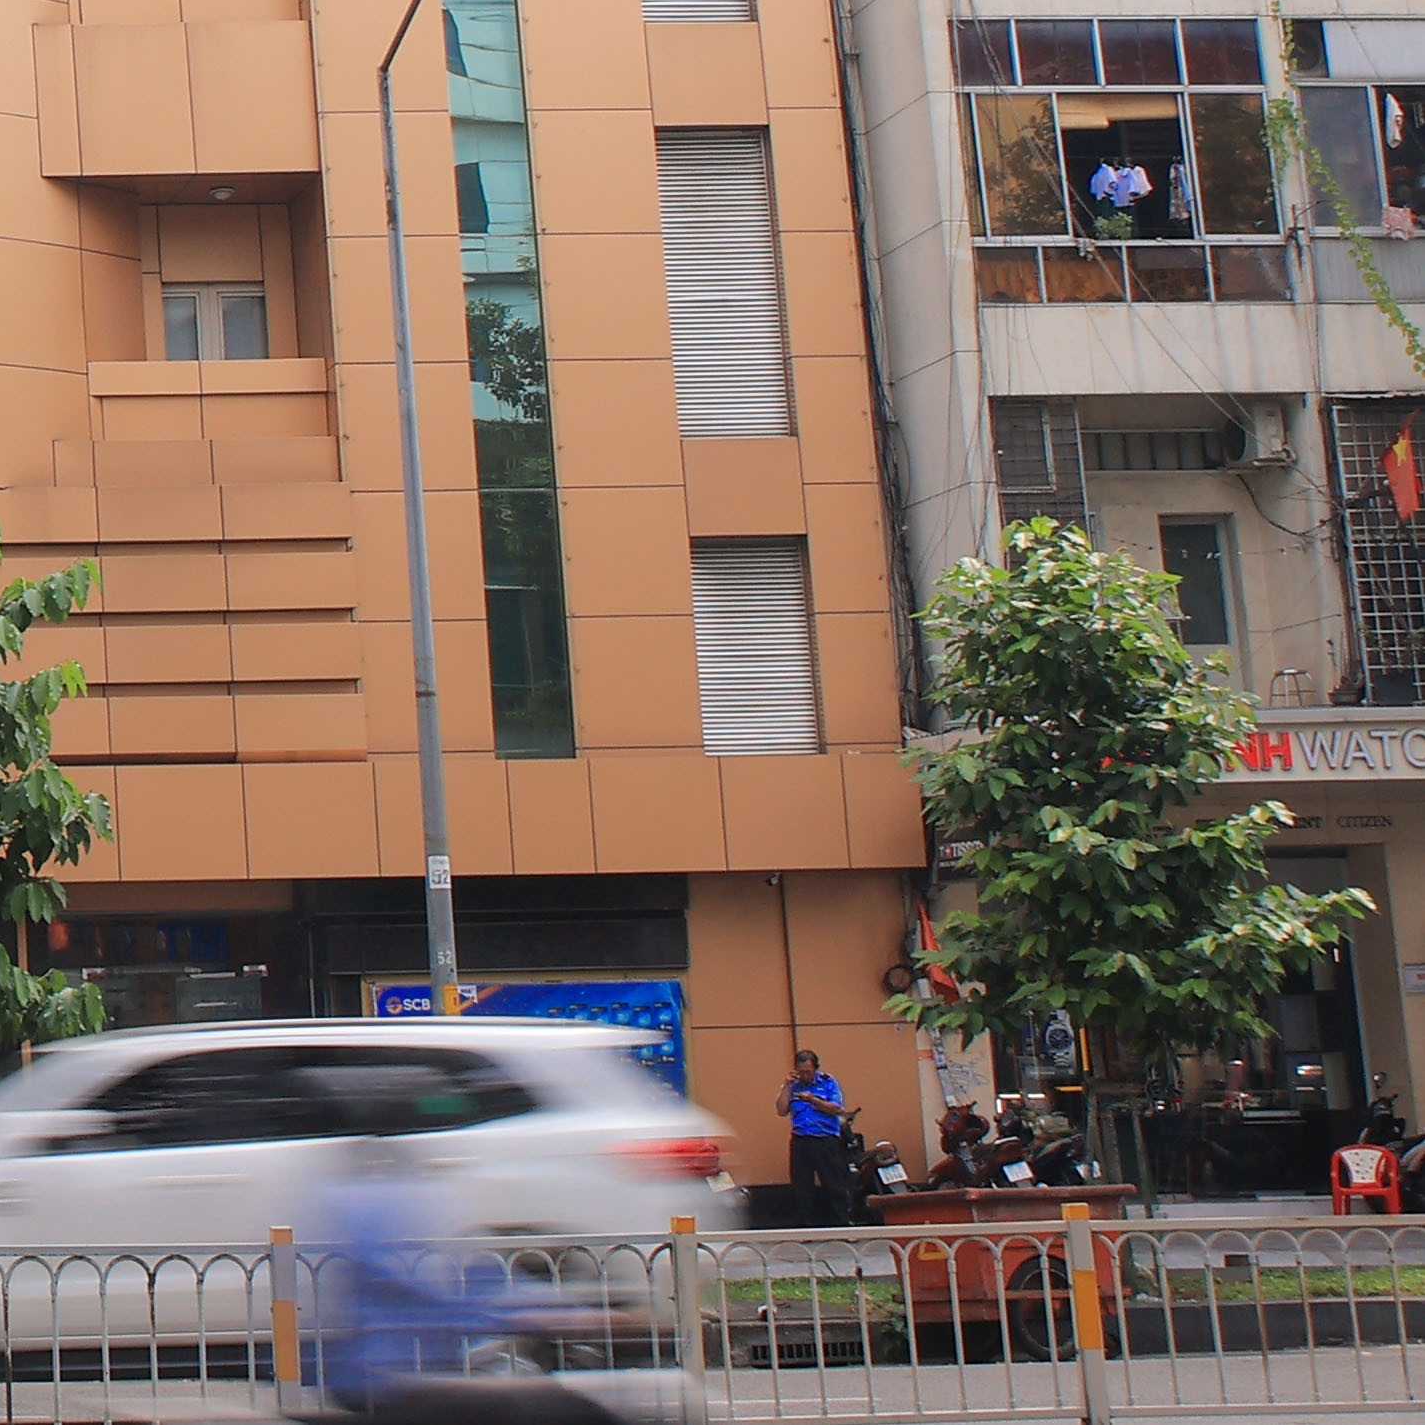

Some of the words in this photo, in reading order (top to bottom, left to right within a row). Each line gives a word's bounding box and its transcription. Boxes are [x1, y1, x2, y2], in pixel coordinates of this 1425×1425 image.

[431, 869, 451, 885] 52
[437, 951, 453, 965] 52
[403, 999, 431, 1011] SCB
